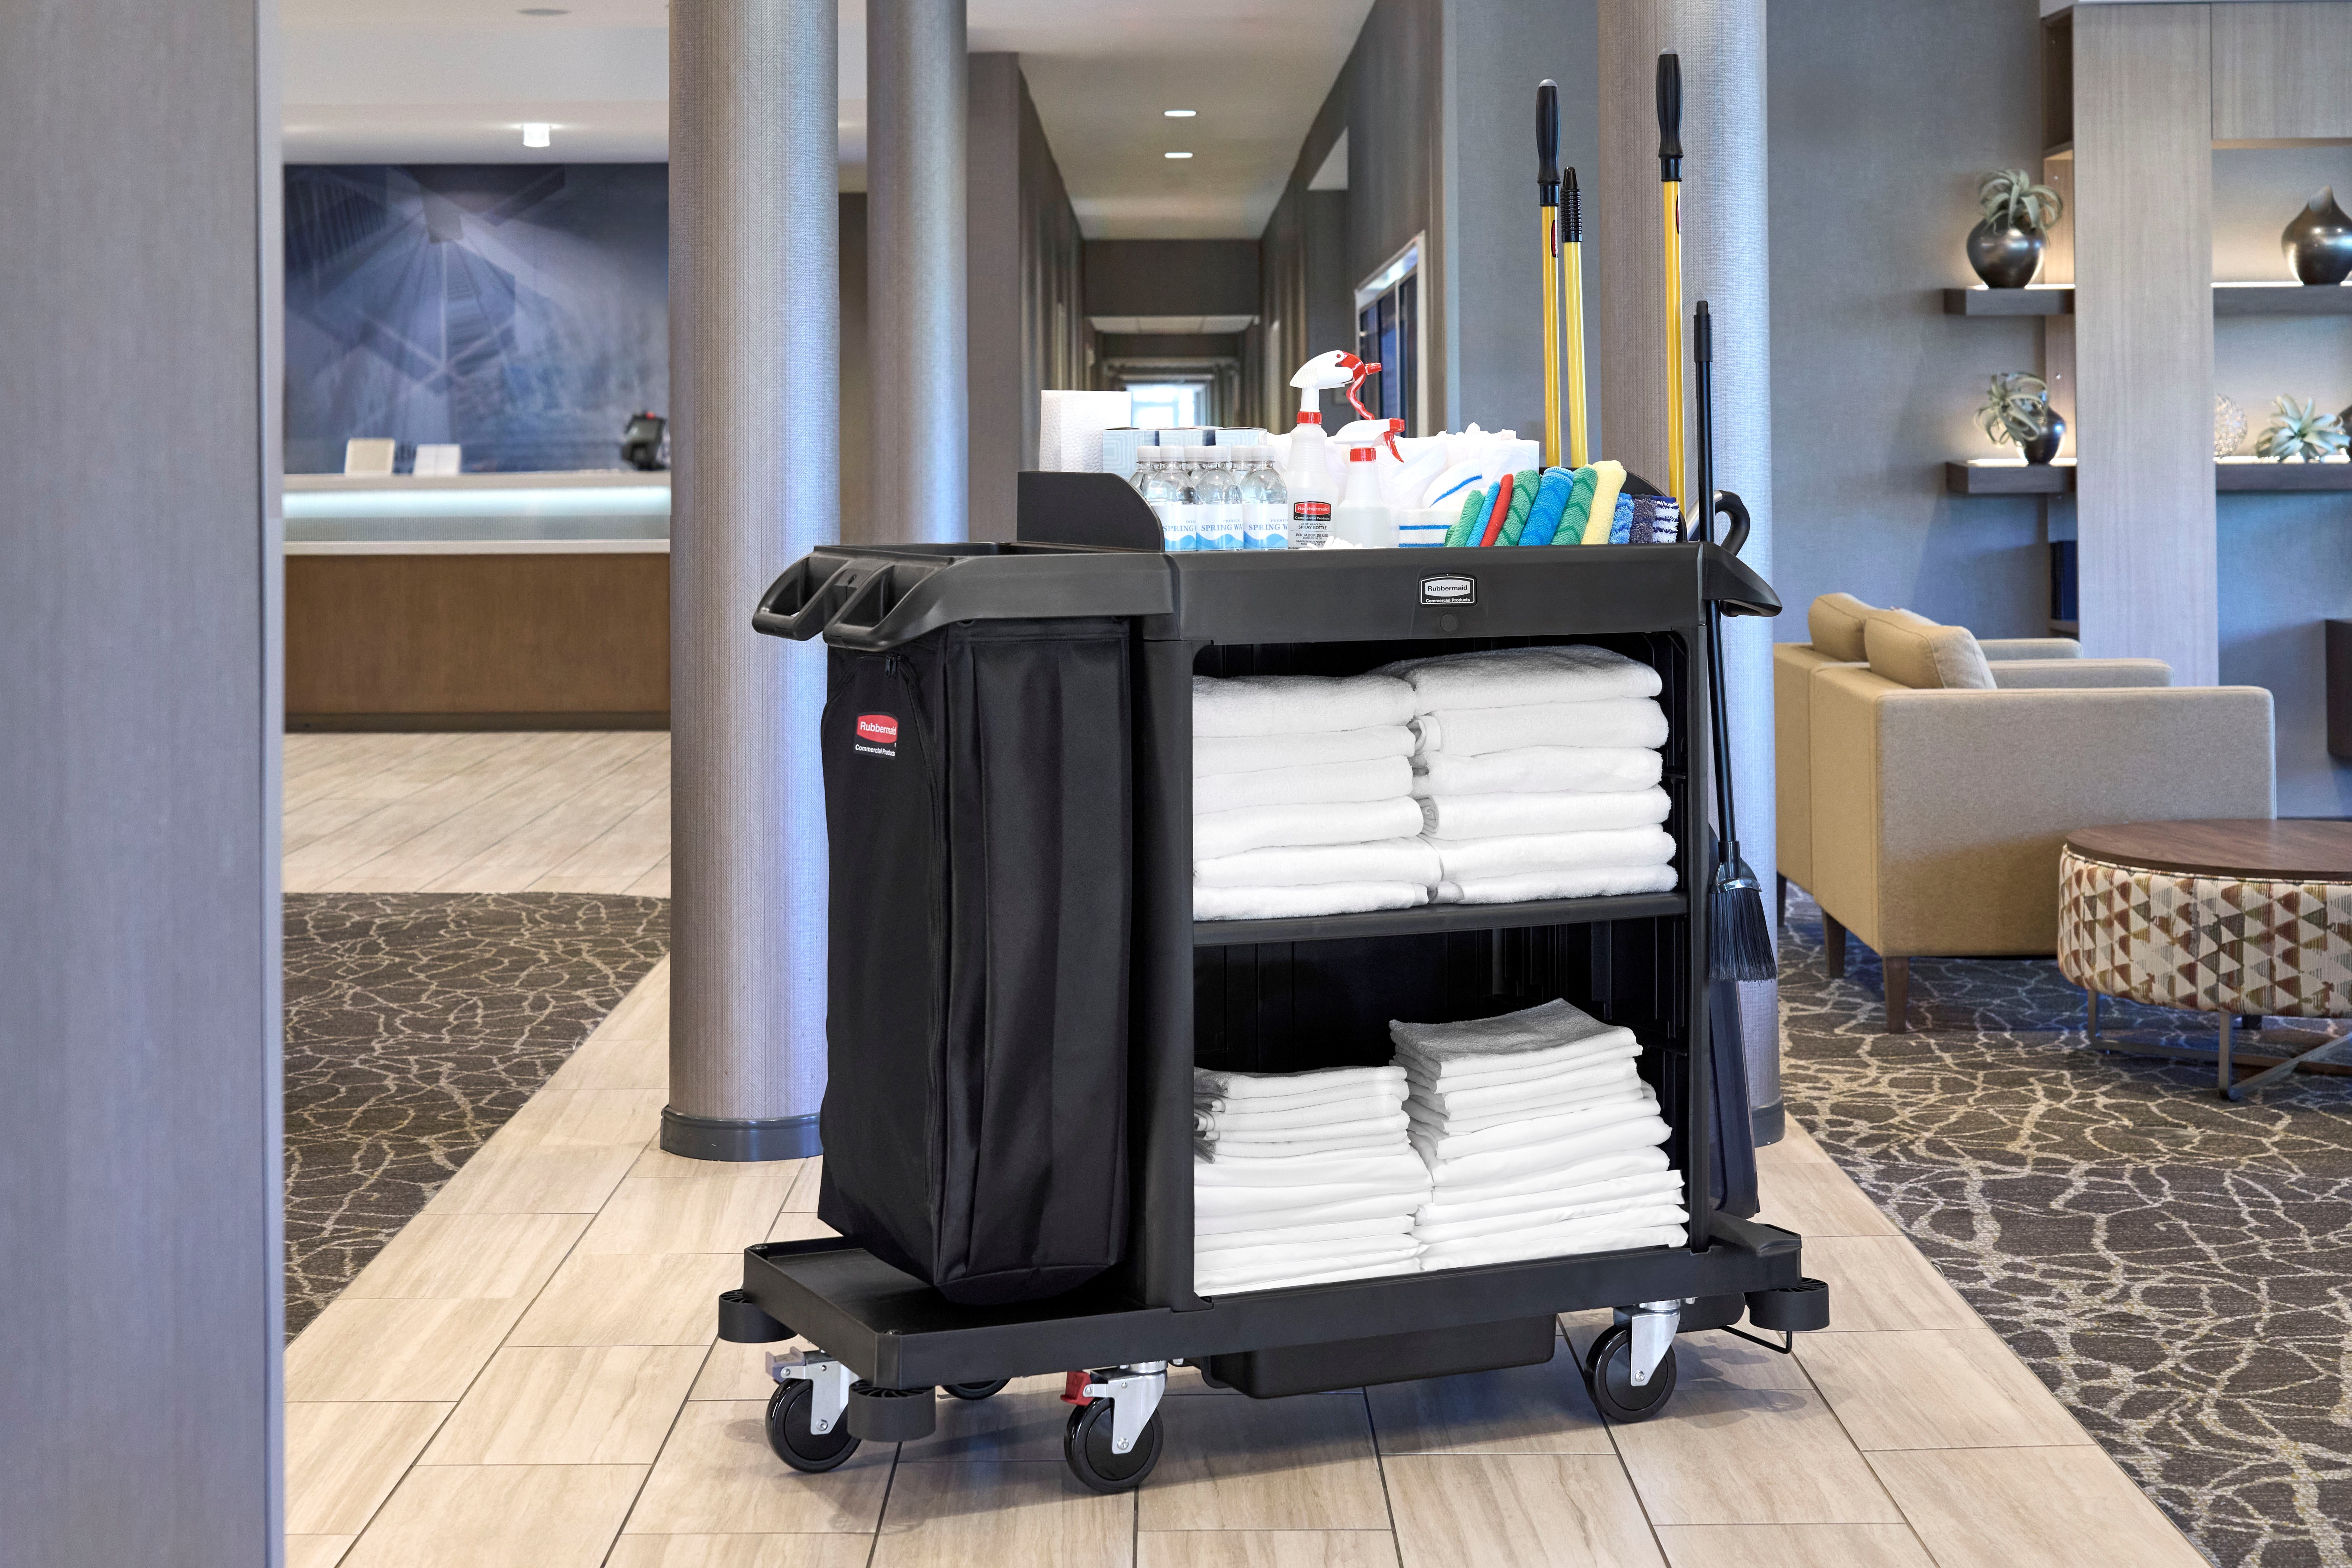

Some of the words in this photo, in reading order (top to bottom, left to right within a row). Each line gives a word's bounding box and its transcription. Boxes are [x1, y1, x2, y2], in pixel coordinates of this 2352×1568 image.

[860, 721, 897, 735] Rubbermaid
[855, 744, 882, 754] Commercial
[882, 748, 895, 757] Products
